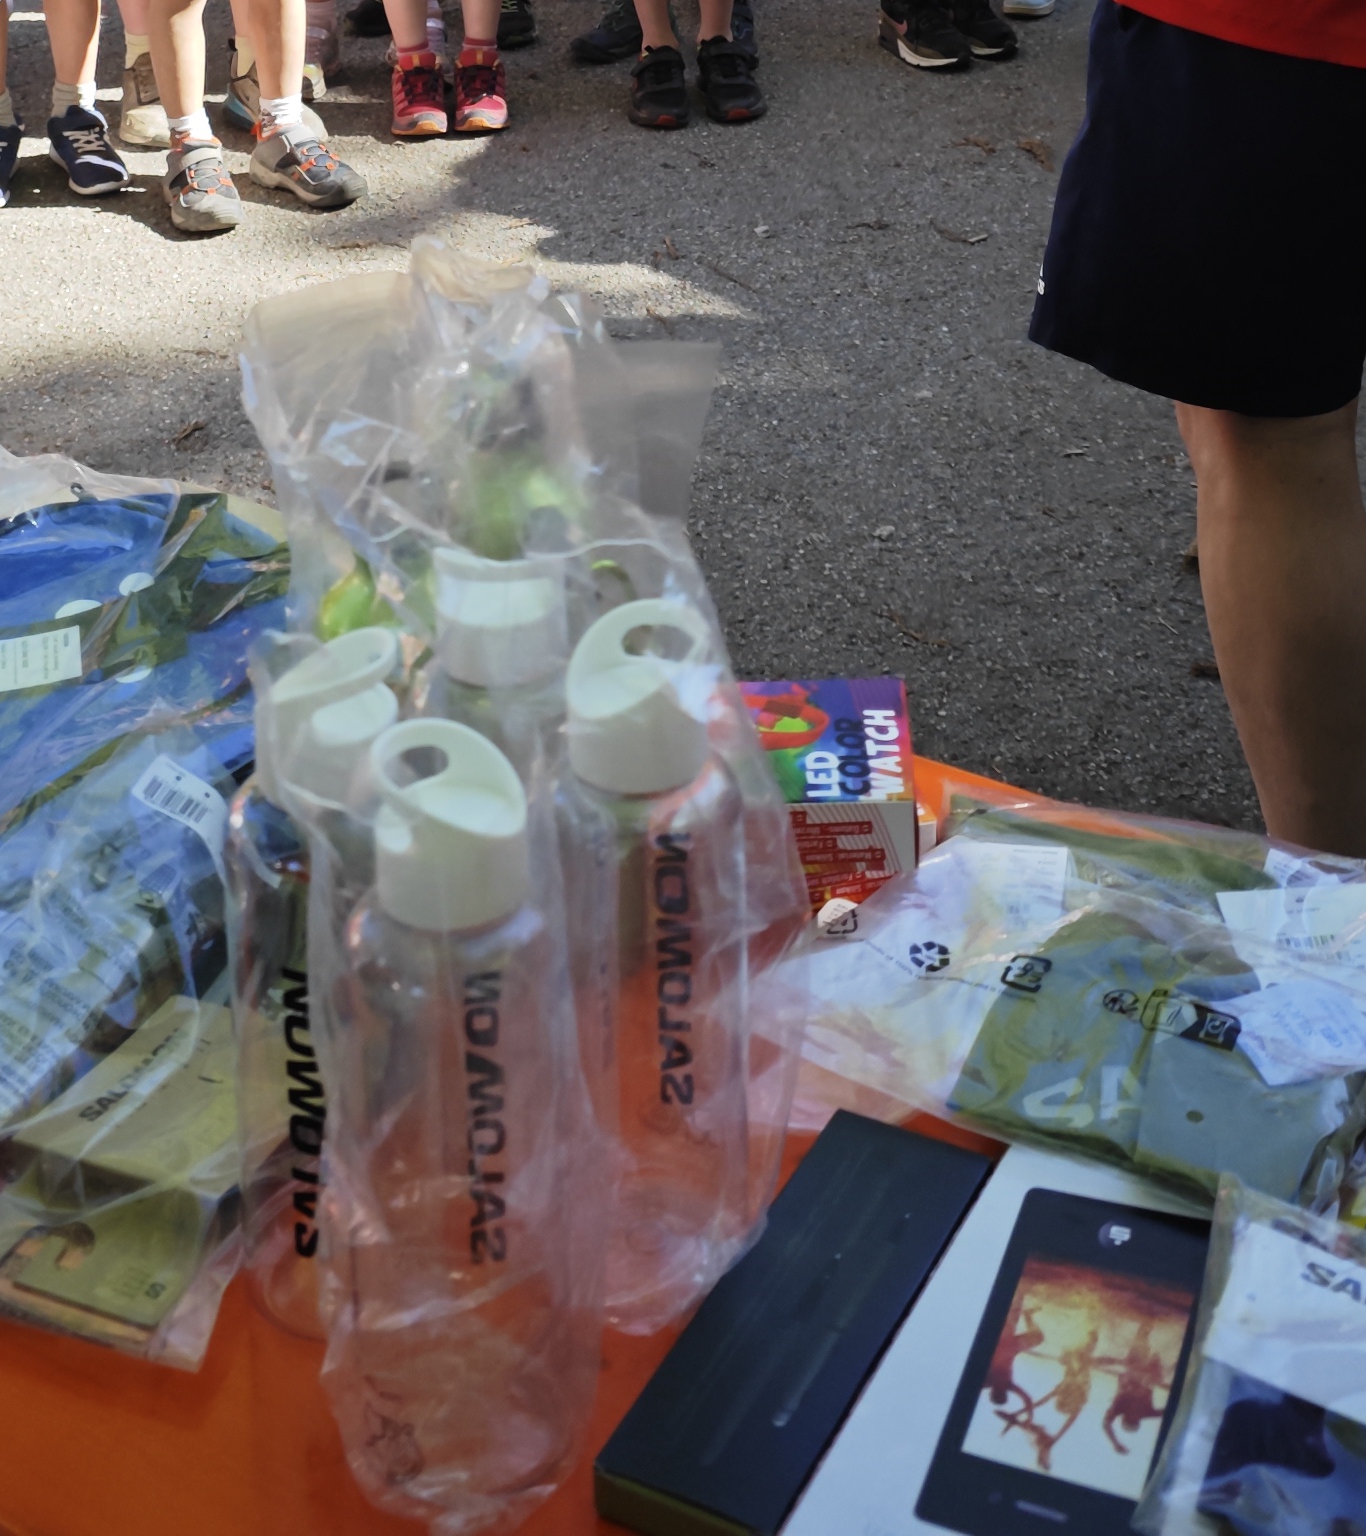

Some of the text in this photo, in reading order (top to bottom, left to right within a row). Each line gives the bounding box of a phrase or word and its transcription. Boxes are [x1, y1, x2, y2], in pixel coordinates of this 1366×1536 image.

[805, 750, 842, 798] LED
[835, 718, 871, 796] COLOR
[861, 709, 904, 800] WATCH
